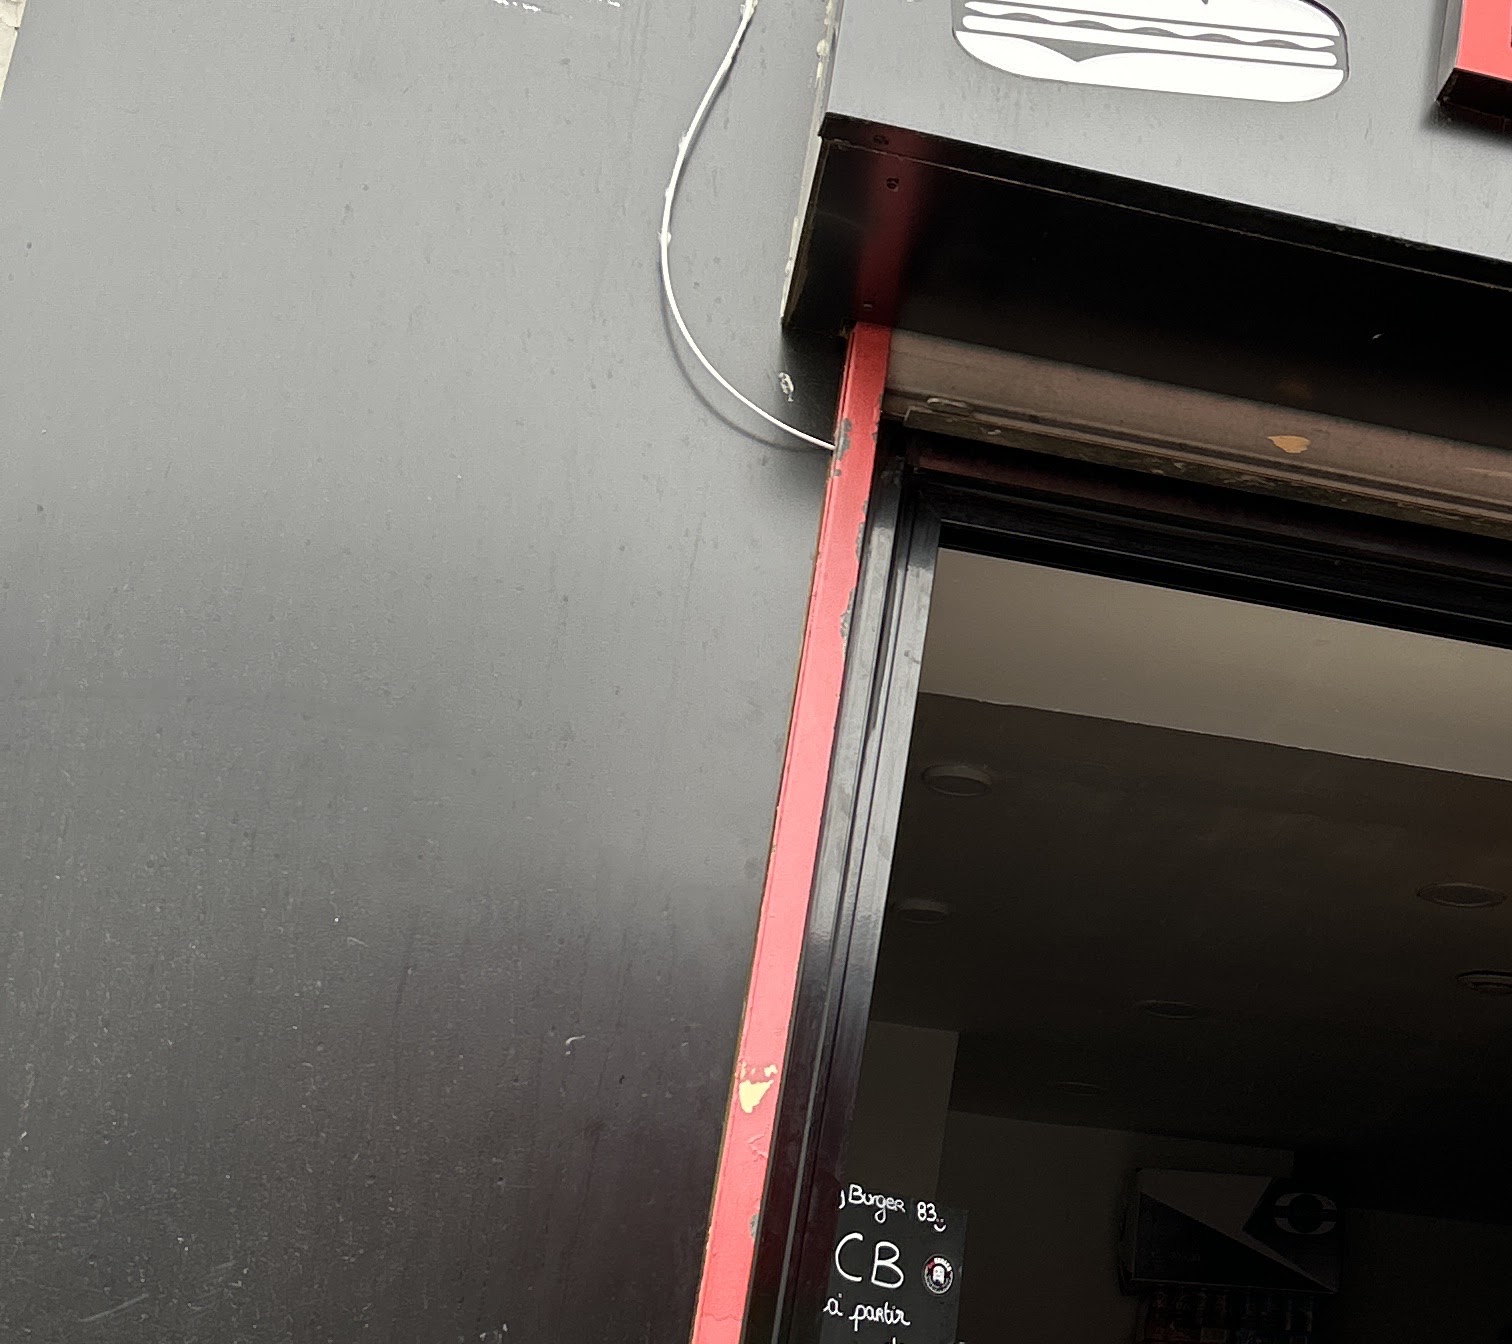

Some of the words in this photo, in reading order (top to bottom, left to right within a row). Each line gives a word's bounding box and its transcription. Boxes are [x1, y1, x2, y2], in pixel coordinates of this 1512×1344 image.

[848, 1183, 906, 1223] Burger
[917, 1201, 938, 1222] 83
[834, 1231, 905, 1289] CB
[849, 1301, 911, 1331] partir
